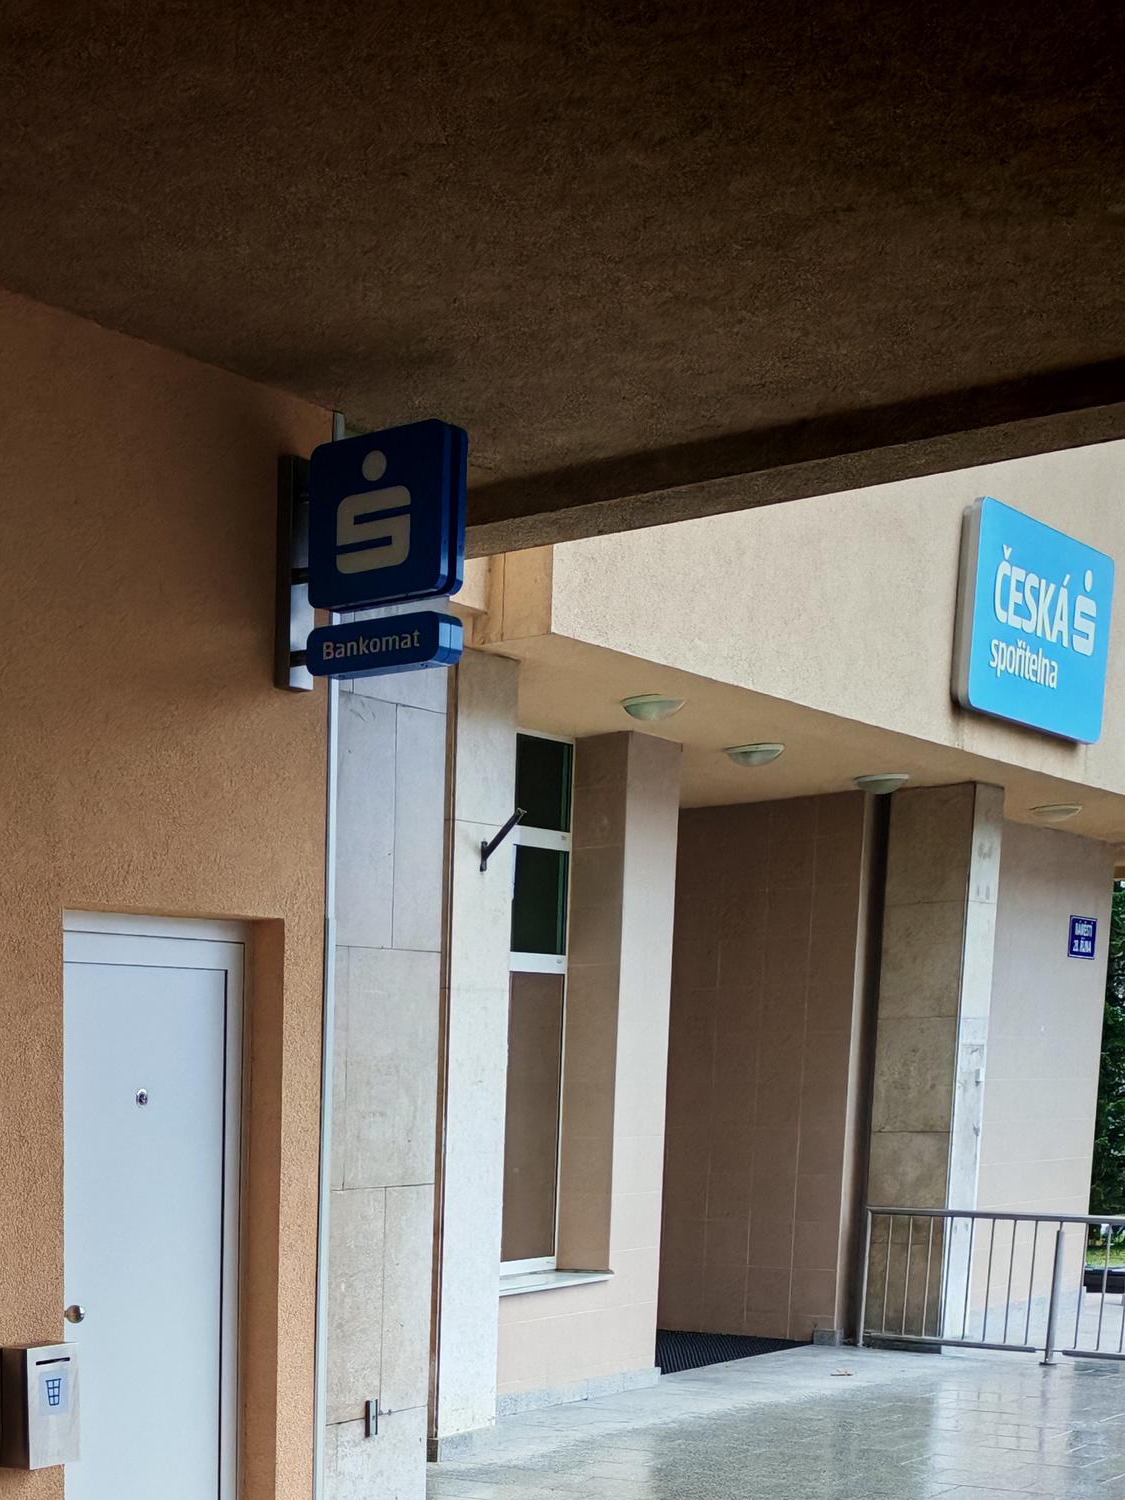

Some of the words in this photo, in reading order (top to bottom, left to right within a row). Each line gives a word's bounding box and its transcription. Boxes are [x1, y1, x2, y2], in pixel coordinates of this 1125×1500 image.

[994, 544, 1070, 648] ČESKÁ
[323, 629, 420, 660] Bankomat
[989, 638, 1059, 689] spořitelna
